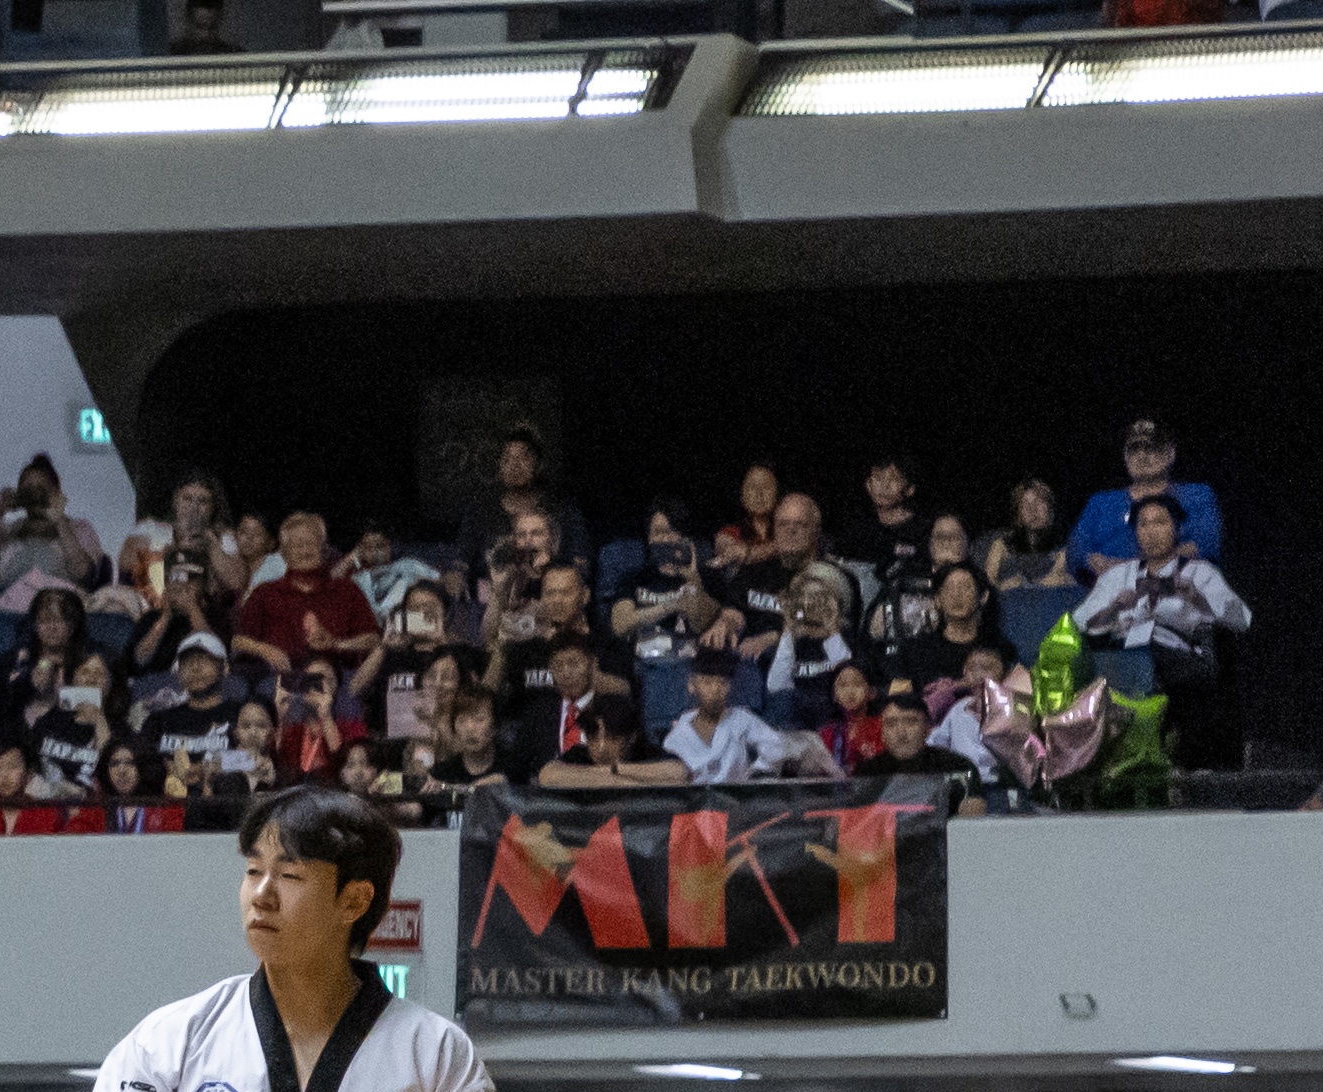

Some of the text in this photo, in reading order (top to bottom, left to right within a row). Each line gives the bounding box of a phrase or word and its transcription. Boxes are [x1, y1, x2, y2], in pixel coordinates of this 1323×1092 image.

[471, 803, 936, 948] MKT
[378, 964, 409, 999] IT
[471, 961, 936, 995] MASTER KANG TAEKWONDO
